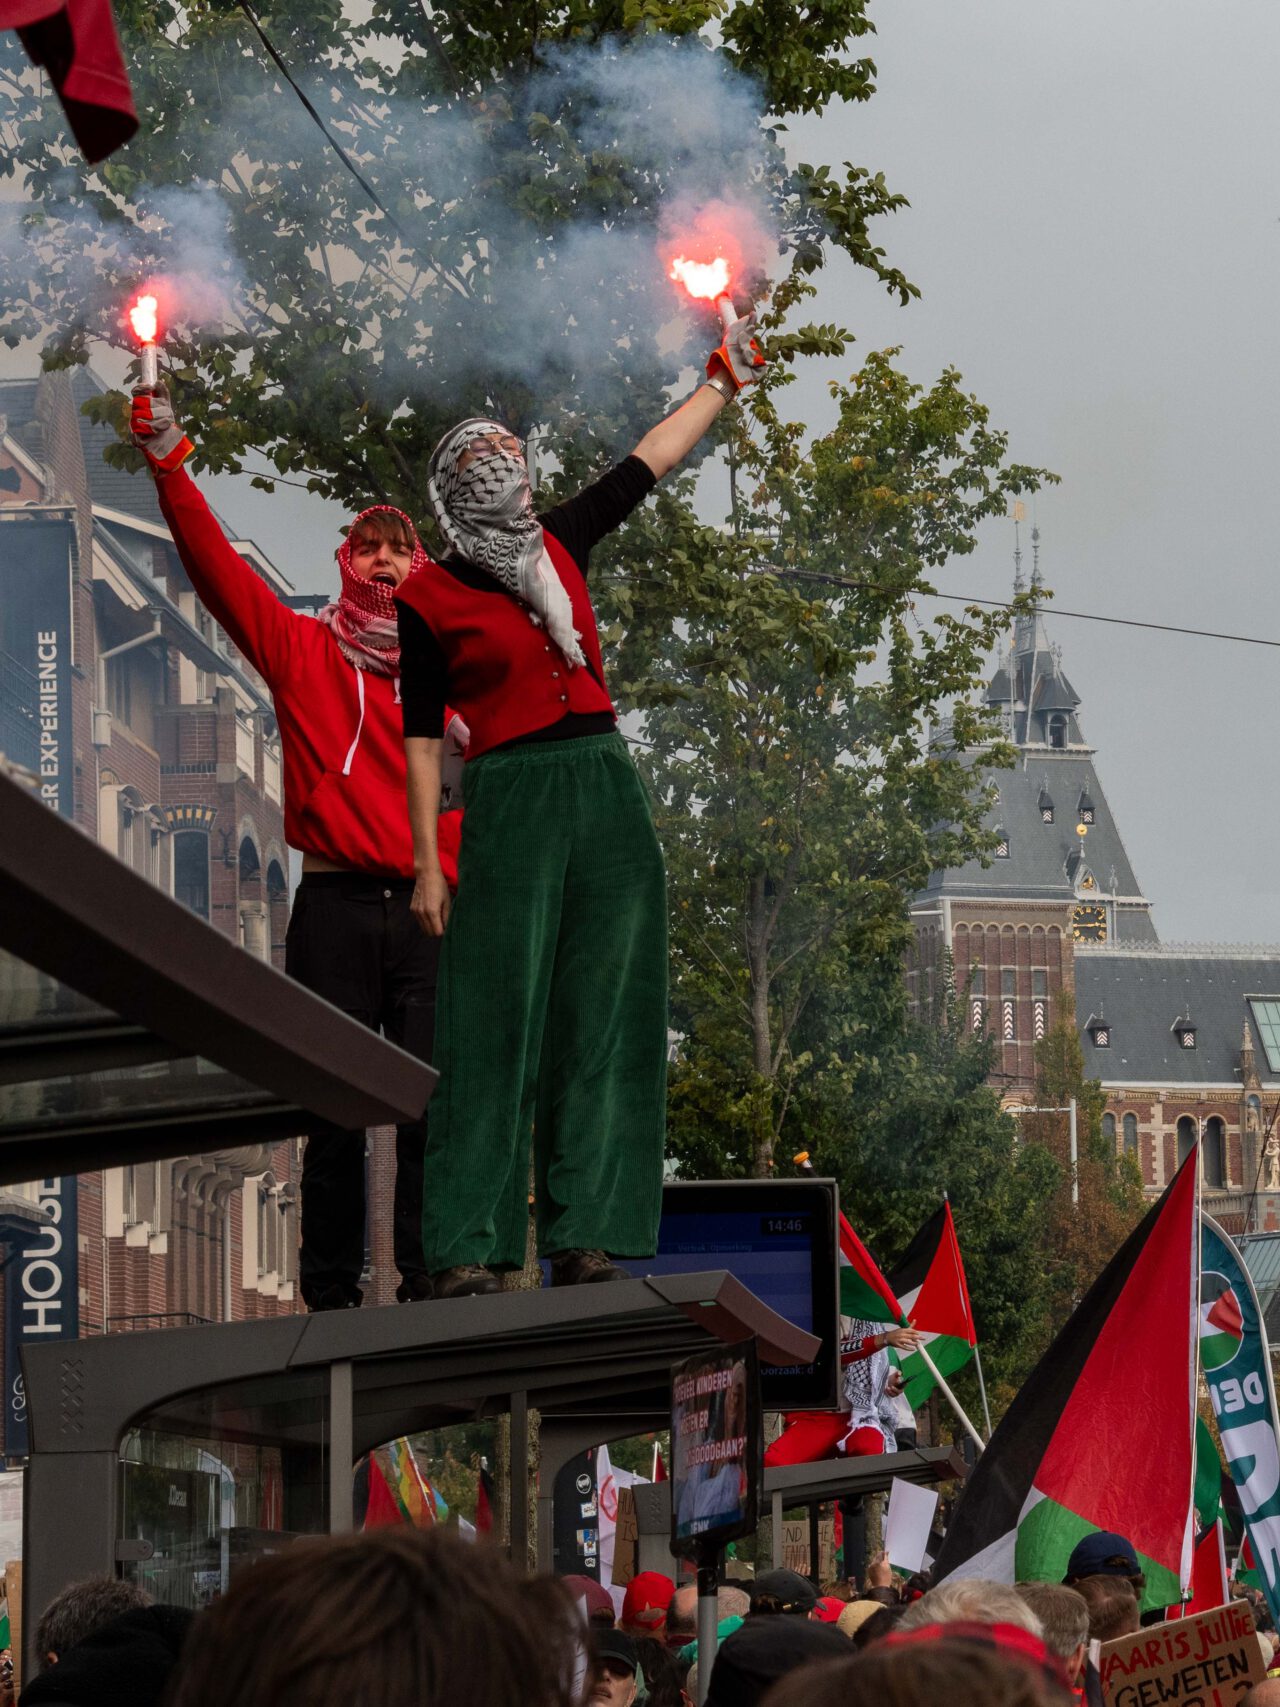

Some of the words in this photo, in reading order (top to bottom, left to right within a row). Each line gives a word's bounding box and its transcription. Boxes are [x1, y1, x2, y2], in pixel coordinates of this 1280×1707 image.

[38, 631, 58, 776] EXPERIENCE
[768, 1219, 803, 1232] 14:46
[1114, 1648, 1249, 1707] GEWETEN
